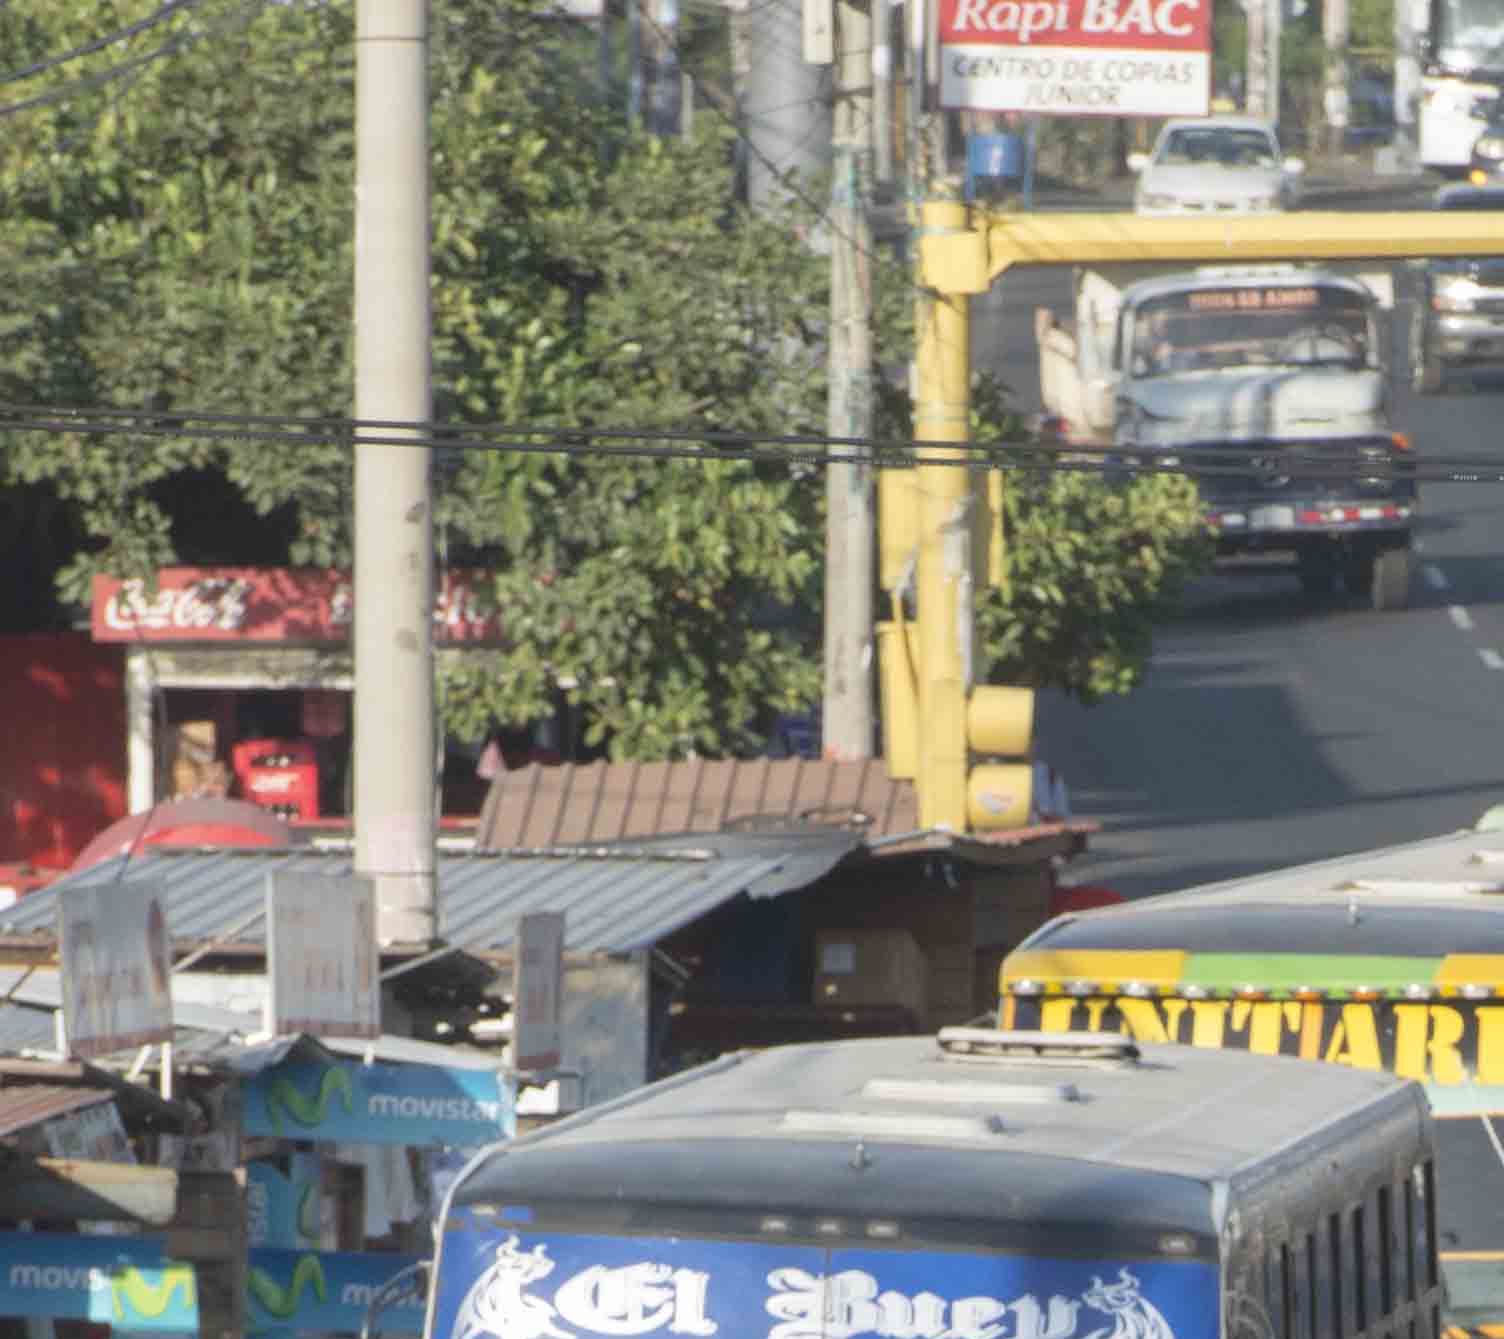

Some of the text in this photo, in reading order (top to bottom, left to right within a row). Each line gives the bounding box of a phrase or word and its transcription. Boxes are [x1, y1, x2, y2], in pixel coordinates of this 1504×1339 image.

[953, 0, 1197, 42] Rapi BAC
[953, 55, 1197, 84] CENTRO DE COPIAS
[1026, 83, 1121, 105] JUNIOR
[367, 1087, 511, 1121] movistar
[555, 1261, 718, 1336] El
